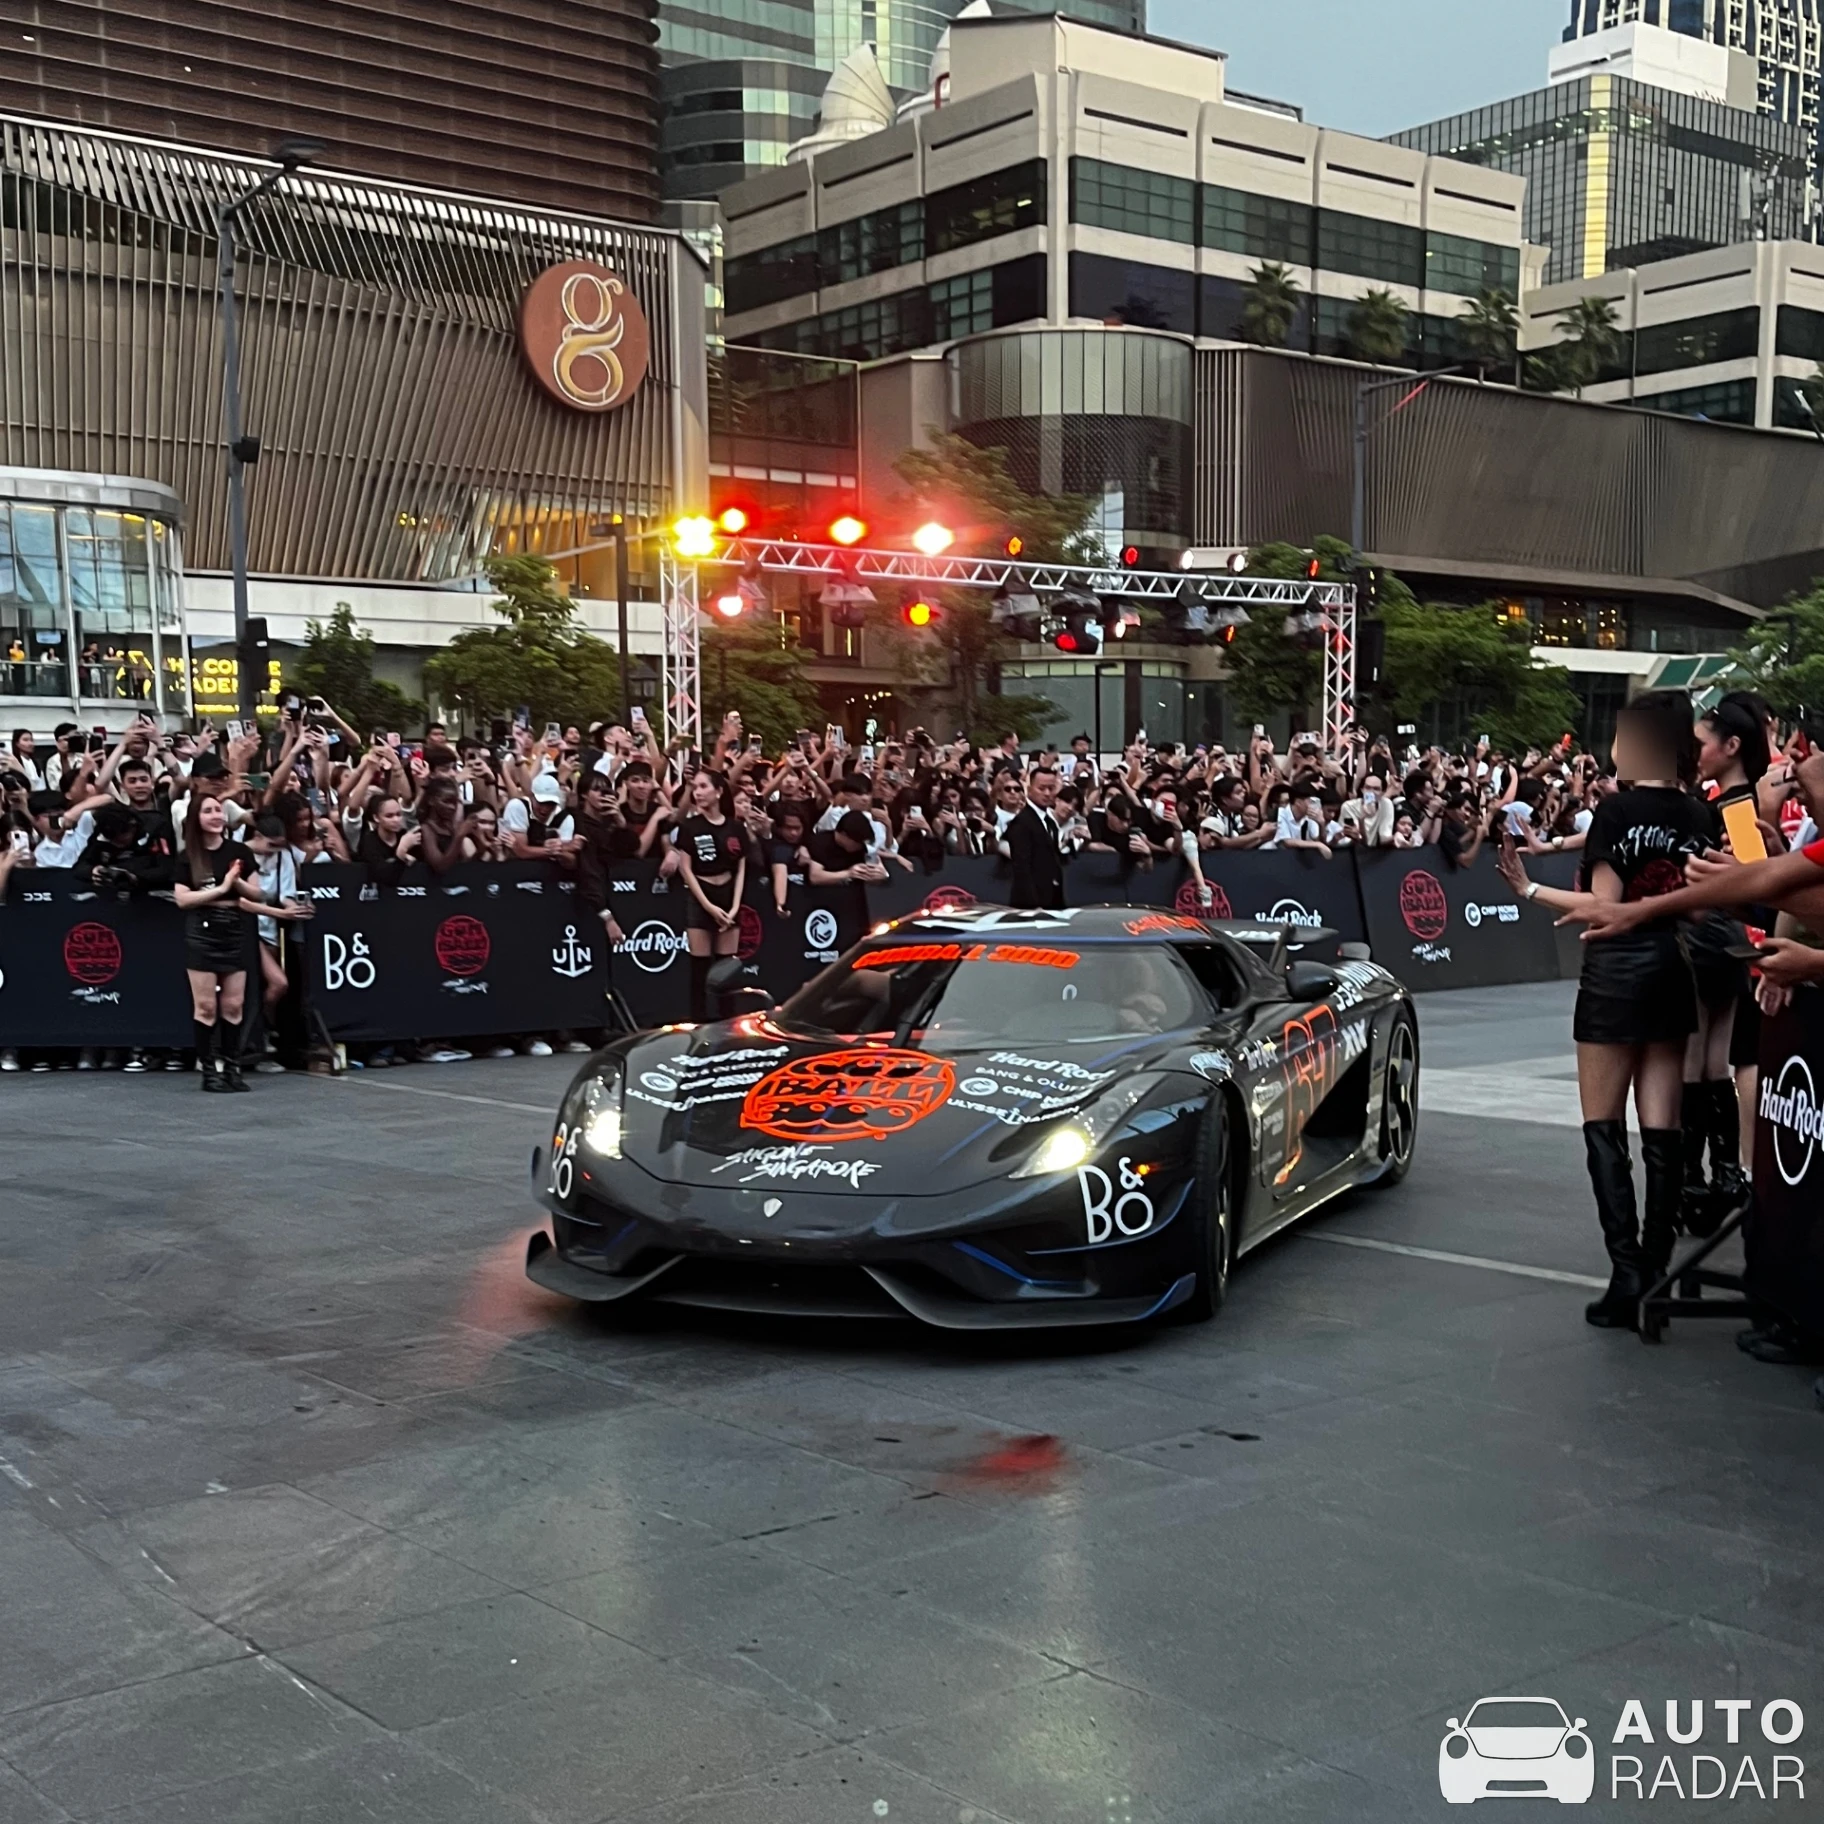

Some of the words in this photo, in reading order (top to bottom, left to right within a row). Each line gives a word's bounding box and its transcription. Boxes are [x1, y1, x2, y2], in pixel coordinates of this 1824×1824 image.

[654, 931, 690, 954] Rock
[1759, 1076, 1796, 1128] Hard
[1077, 1156, 1154, 1244] B&O
